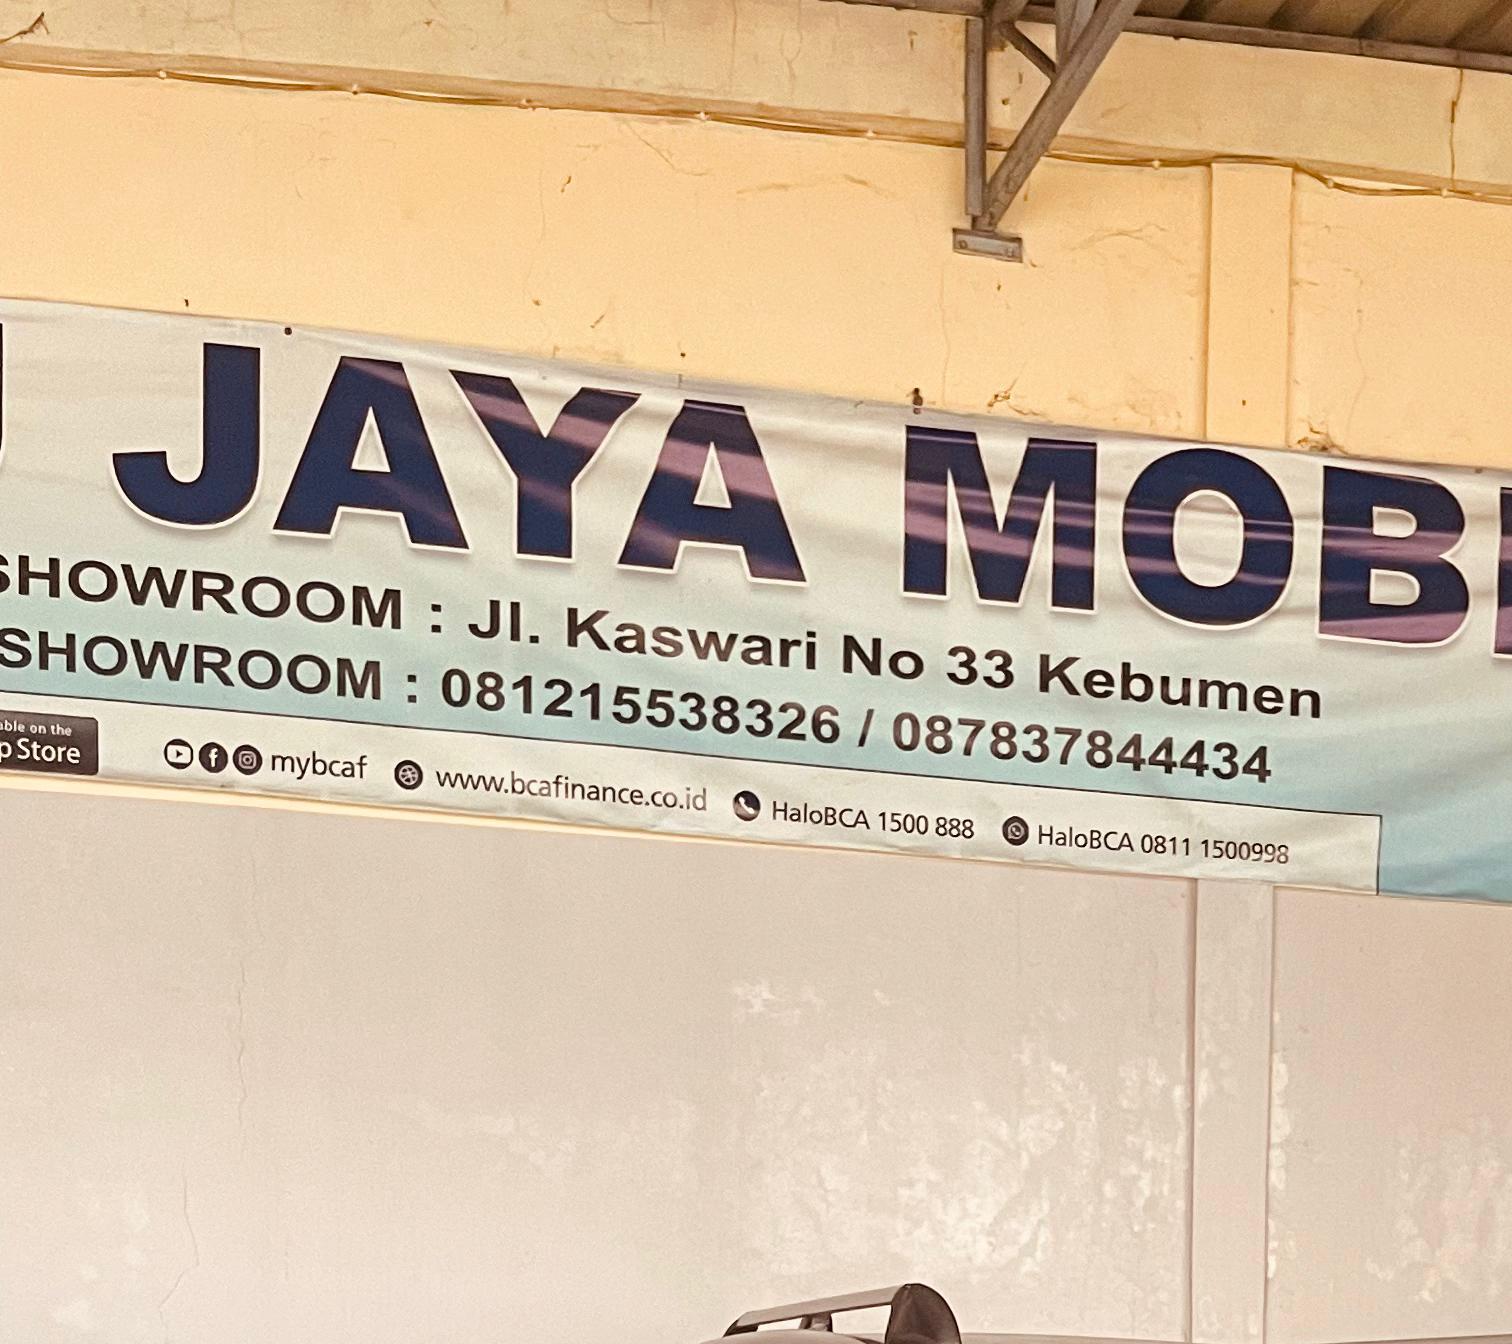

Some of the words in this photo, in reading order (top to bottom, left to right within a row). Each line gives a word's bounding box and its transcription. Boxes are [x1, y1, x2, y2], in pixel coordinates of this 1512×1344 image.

[112, 342, 806, 586] JAYA
[0, 555, 402, 630] HOWROOM
[430, 603, 444, 634] :
[468, 599, 540, 645] Jl.
[566, 606, 817, 672] Kaswari
[841, 634, 925, 680] No
[945, 646, 1015, 690] 33
[1038, 655, 1323, 720] Kebumen
[0, 626, 382, 701] SHOWROOM
[406, 671, 419, 704] :
[441, 667, 841, 745] 081215538326
[857, 708, 874, 748] /
[891, 712, 1272, 784] 087837844434
[30, 724, 46, 734] on
[51, 724, 72, 736] the
[17, 738, 81, 764] Store
[270, 752, 367, 781] mybcaf
[434, 768, 708, 812] www.bcafinance.co.id
[771, 801, 870, 830] HaloBCA
[878, 812, 929, 836] 1500
[935, 816, 975, 840] 888
[1038, 824, 1134, 852] HaloBCA
[1141, 834, 1191, 856] 0811
[1201, 838, 1289, 864] 1500998
